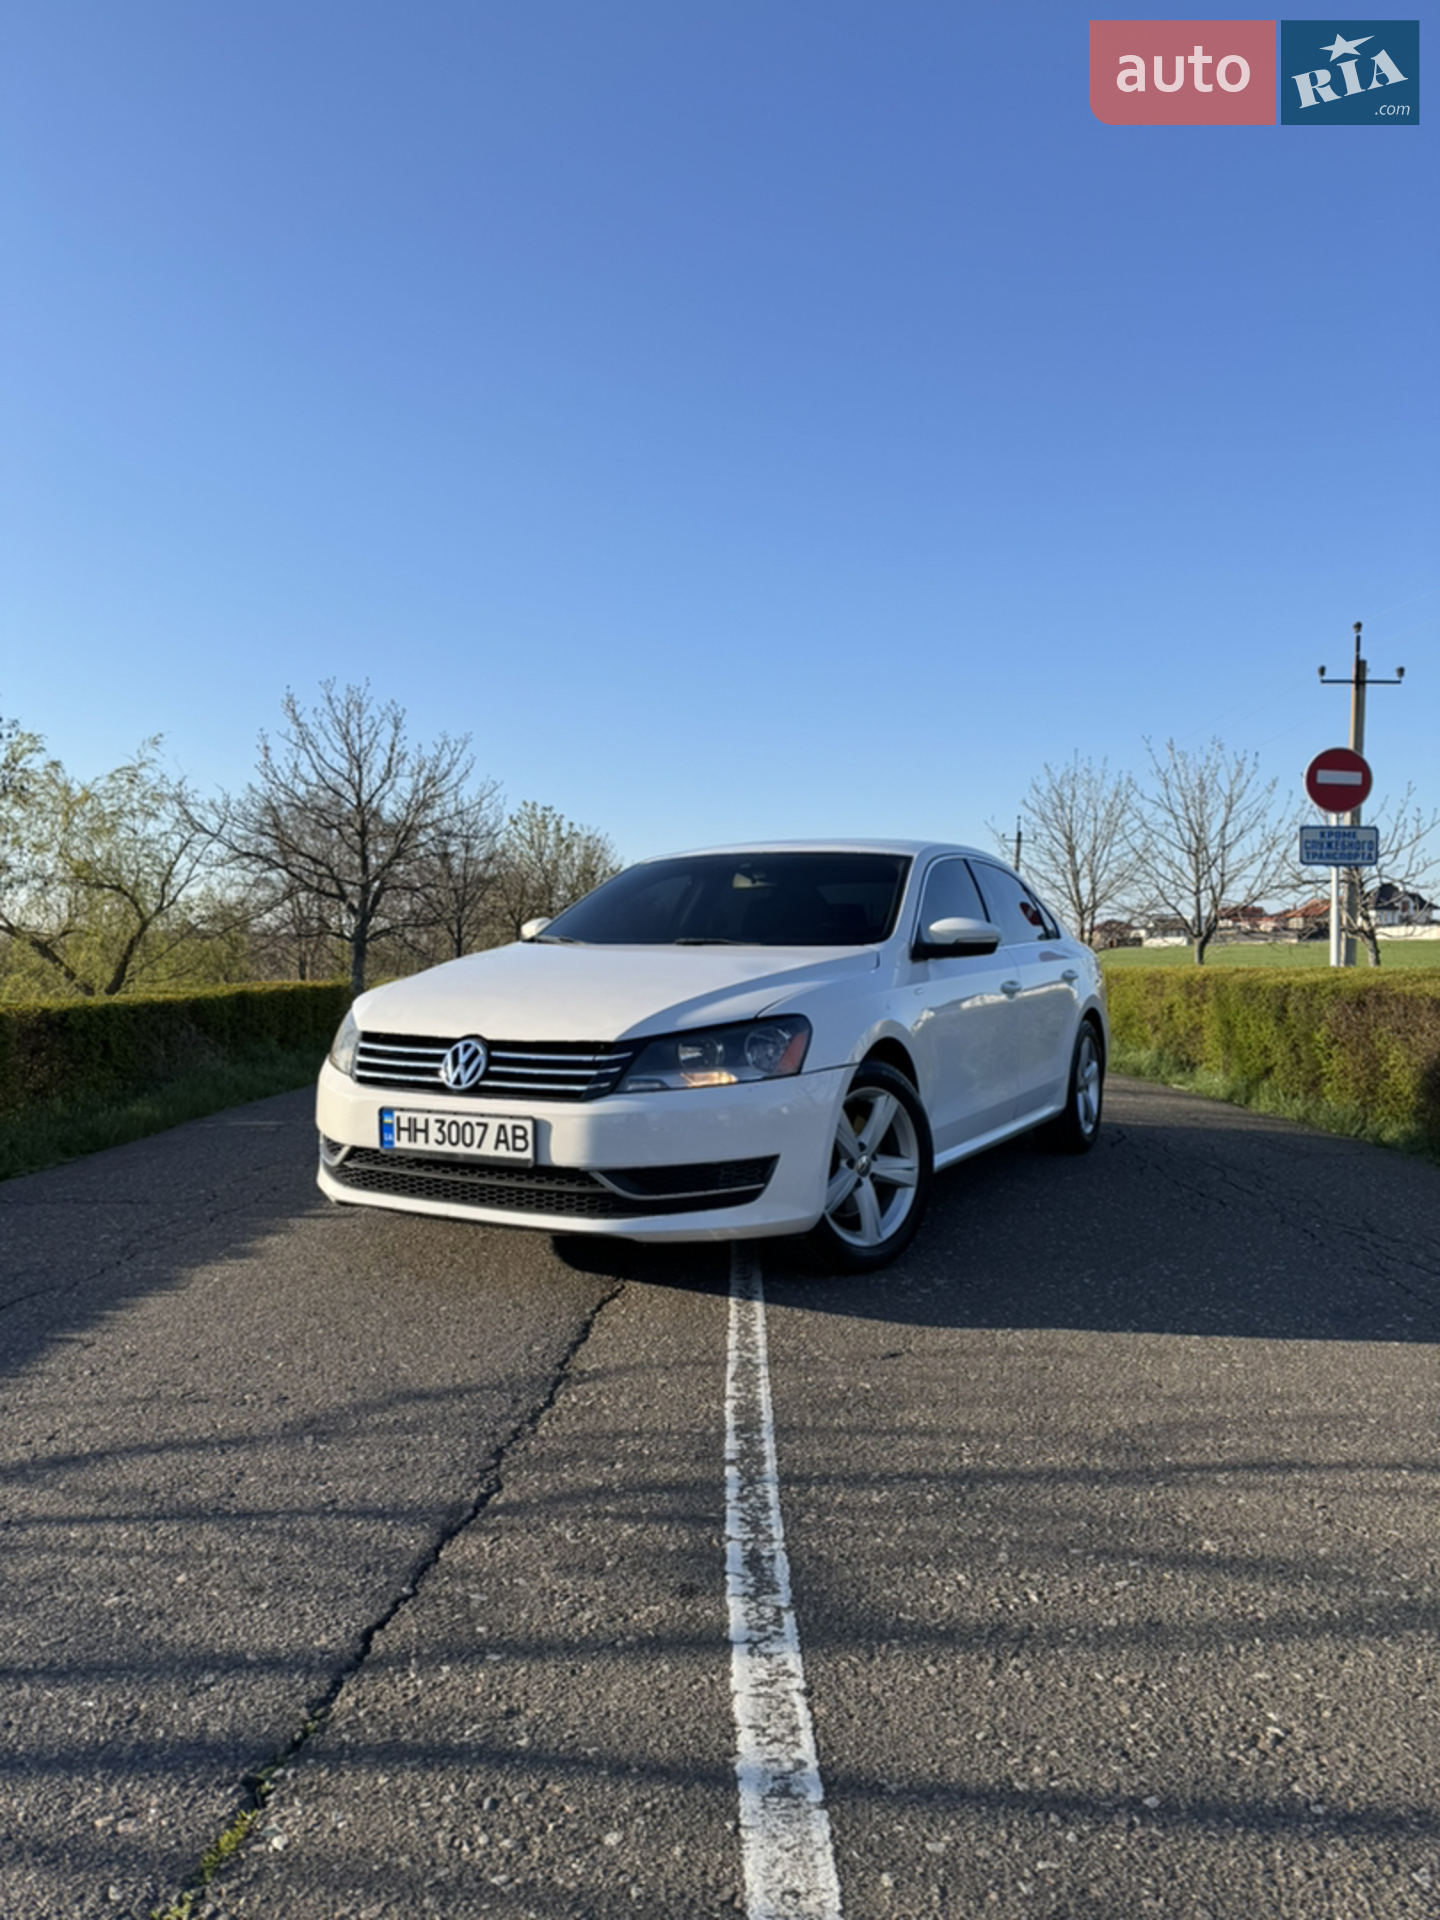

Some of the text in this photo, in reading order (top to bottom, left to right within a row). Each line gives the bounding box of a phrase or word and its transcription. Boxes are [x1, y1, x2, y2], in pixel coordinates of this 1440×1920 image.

[1320, 831, 1357, 839] КРОМЕ
[396, 1115, 530, 1152] HH 3007 AB
